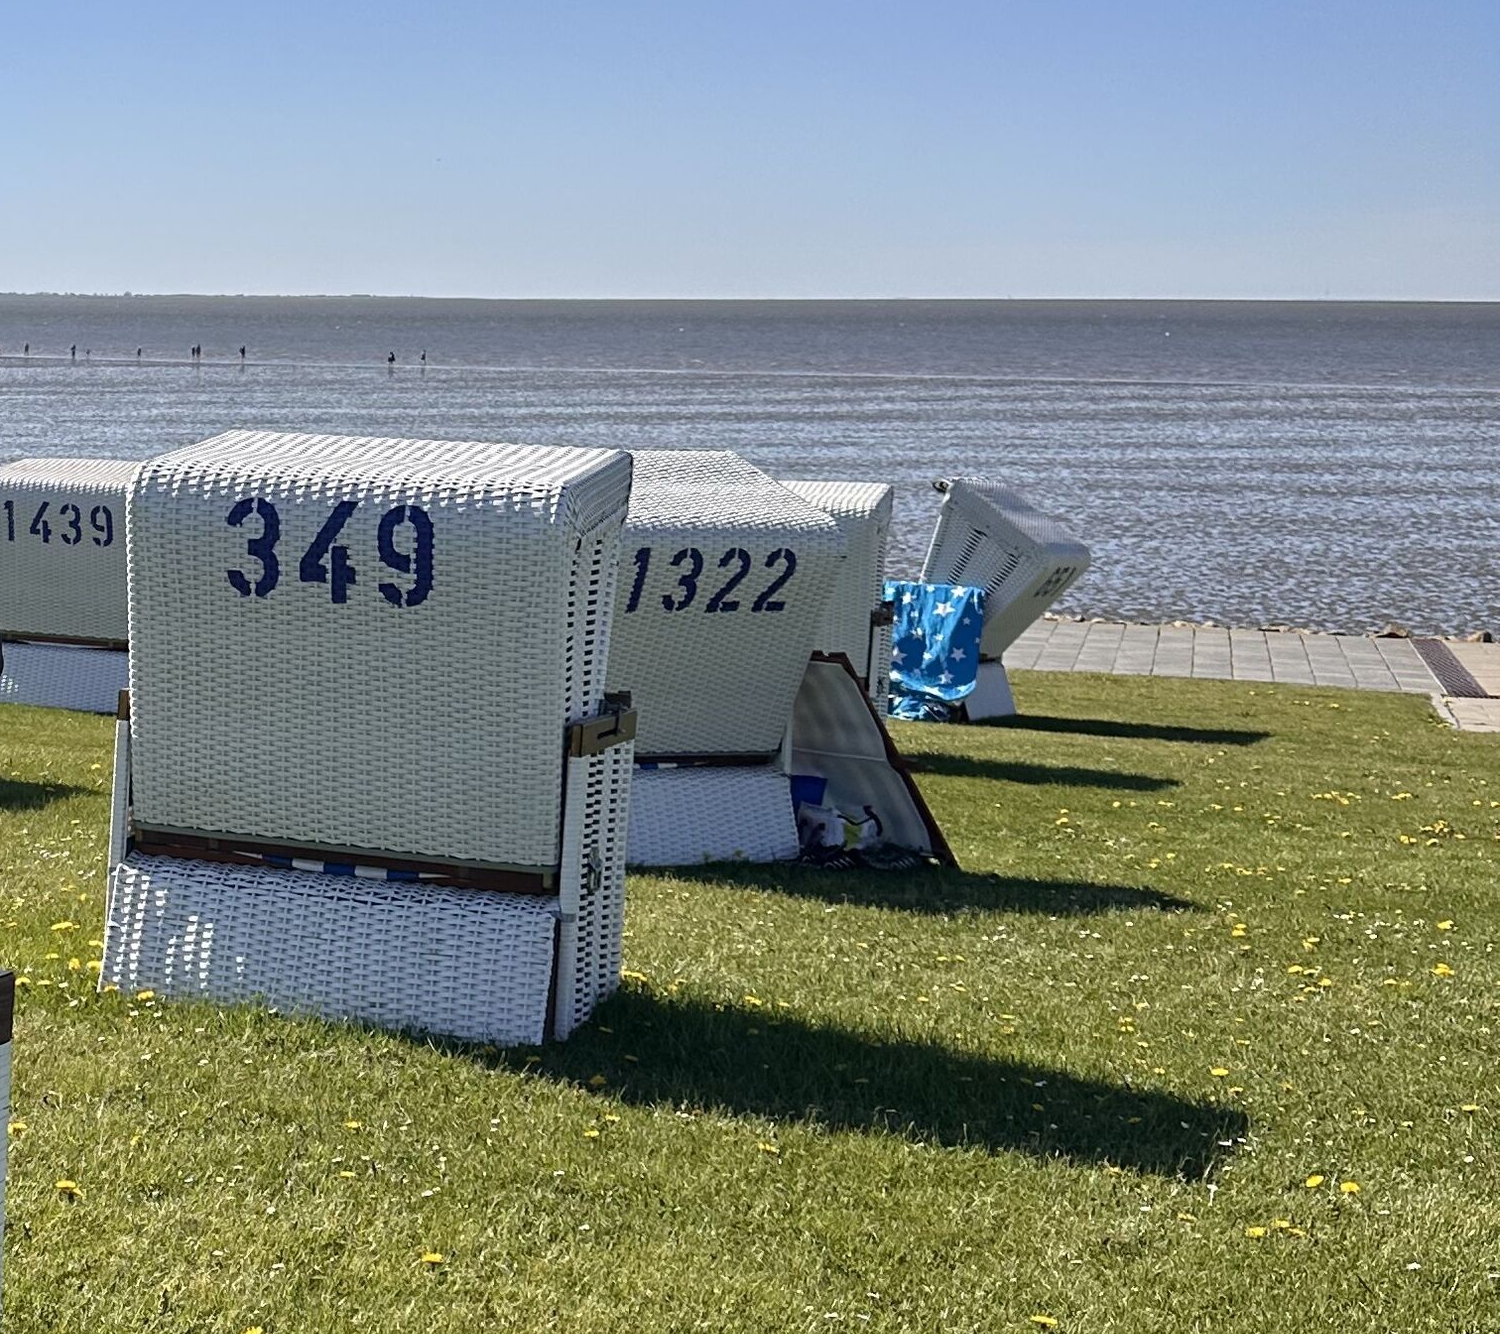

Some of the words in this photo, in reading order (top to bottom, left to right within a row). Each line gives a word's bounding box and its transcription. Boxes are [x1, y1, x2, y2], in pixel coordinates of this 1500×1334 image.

[3, 500, 114, 547] 1439
[227, 497, 435, 608] 349
[624, 547, 797, 614] 1322
